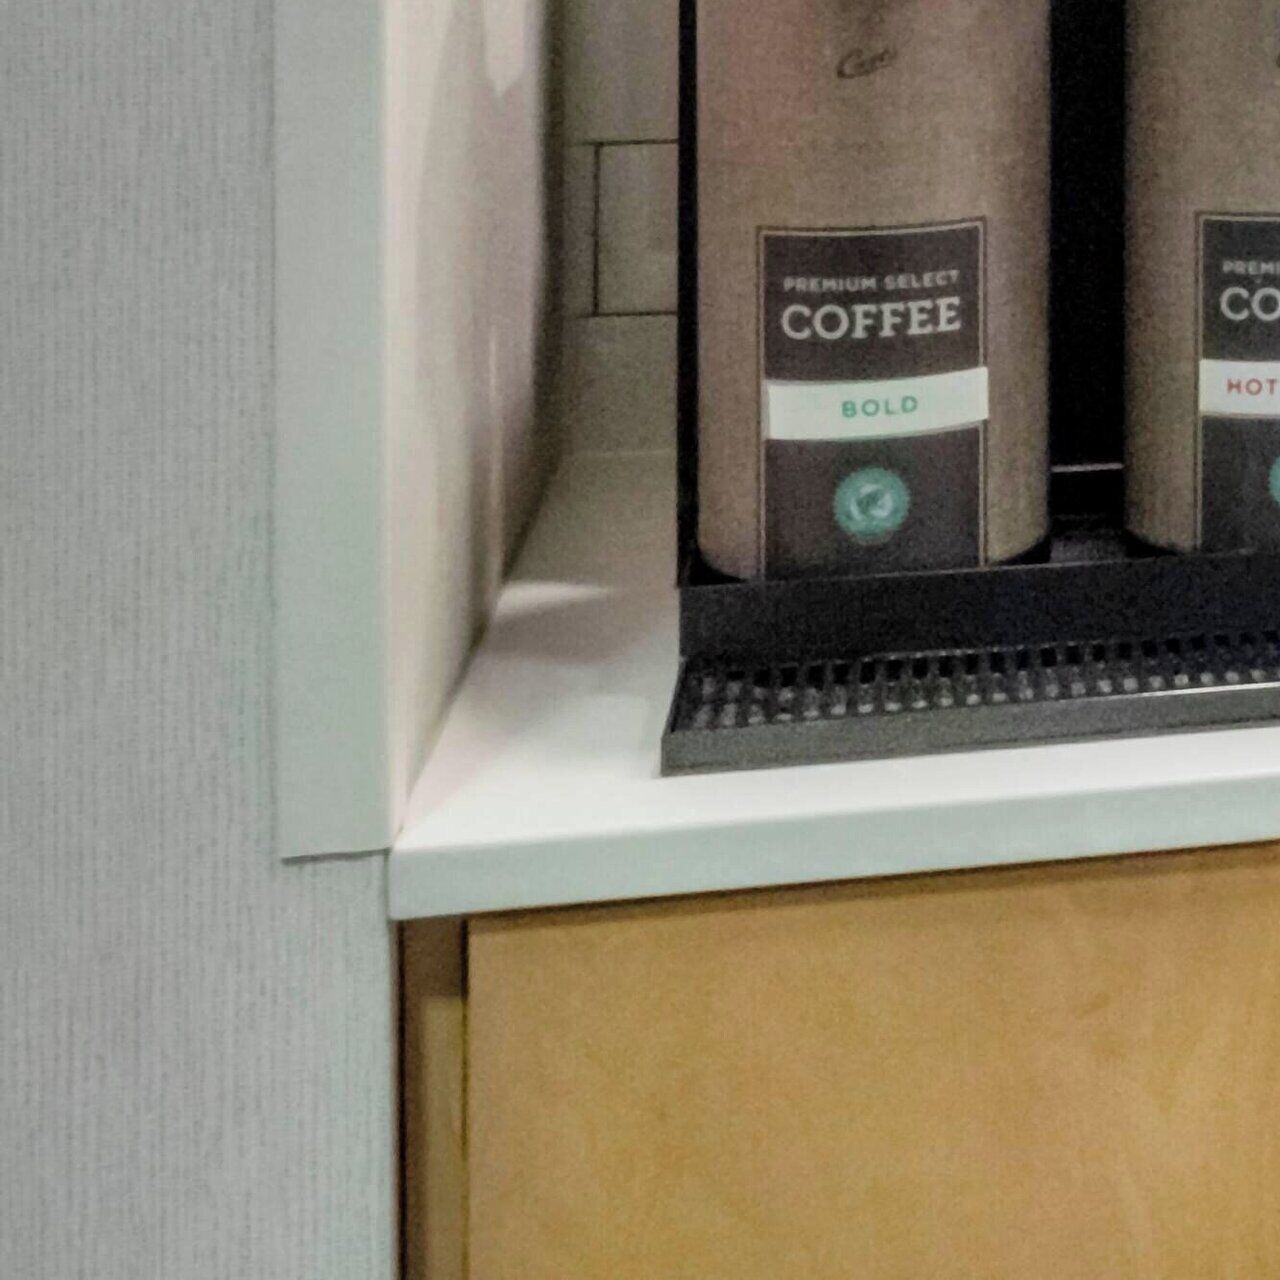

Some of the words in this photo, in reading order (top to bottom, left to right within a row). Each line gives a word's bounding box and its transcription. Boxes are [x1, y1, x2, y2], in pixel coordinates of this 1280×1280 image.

[783, 276, 877, 292] PREMIUM
[883, 269, 960, 291] SELECT
[781, 296, 962, 340] COFFEE
[1226, 377, 1278, 396] HOT
[842, 395, 918, 418] BOLD
